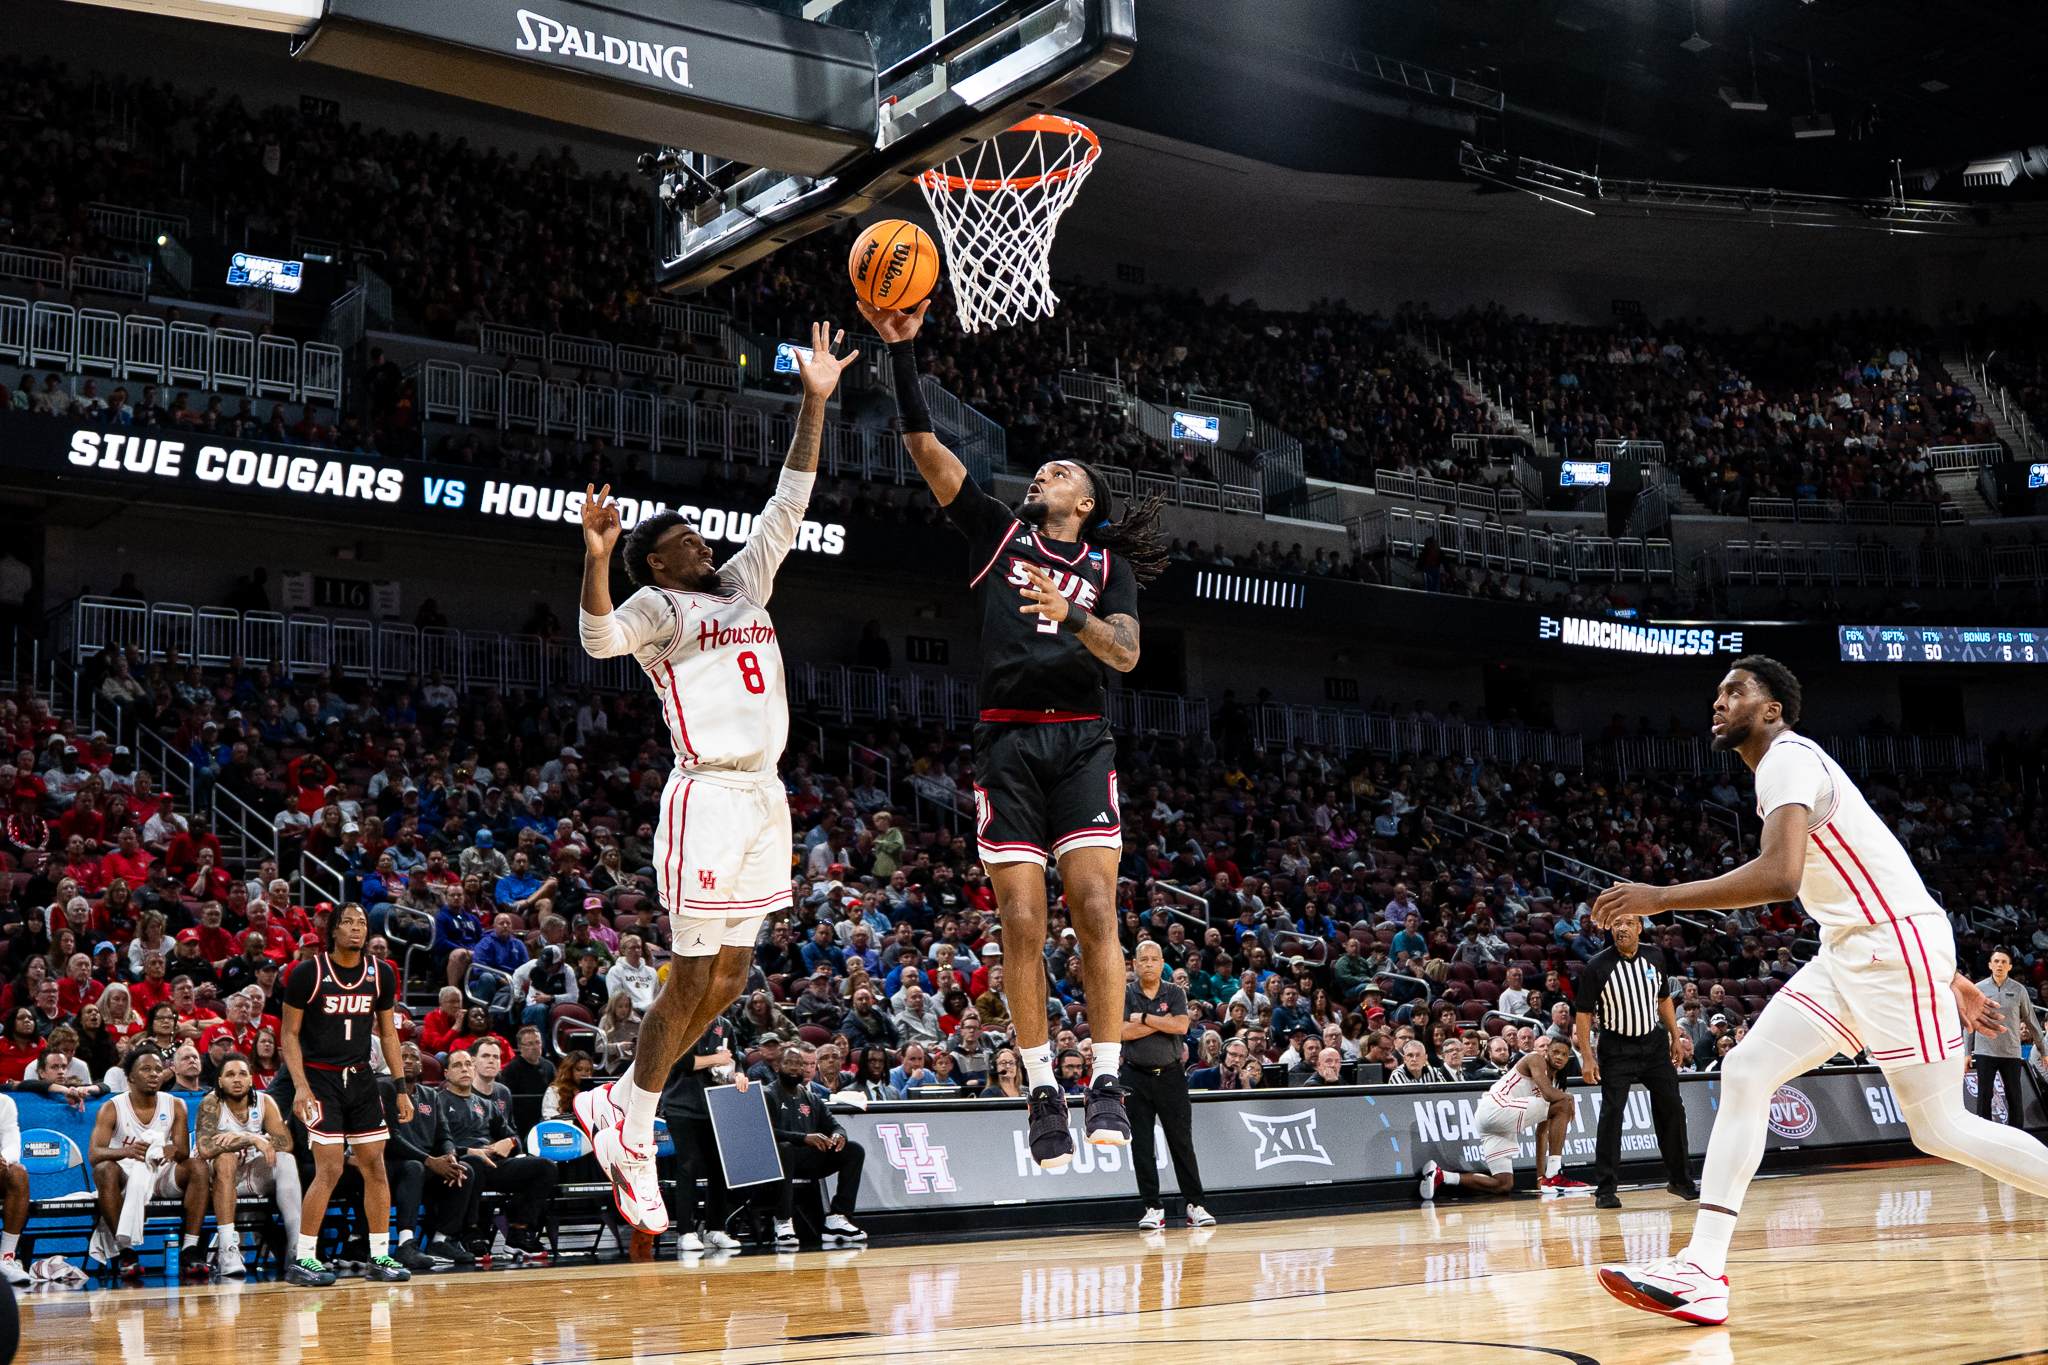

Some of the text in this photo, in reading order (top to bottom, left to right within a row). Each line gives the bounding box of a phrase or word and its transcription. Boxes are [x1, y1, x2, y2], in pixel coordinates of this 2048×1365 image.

[516, 9, 692, 88] SPALDING
[858, 239, 879, 281] NCAA
[878, 242, 911, 297] Wilson
[68, 430, 404, 502] SIUE COUGARS
[423, 476, 466, 507] VS
[324, 580, 365, 607] 116
[697, 619, 776, 651] Houston
[1845, 630, 2035, 643] FG% 3PT% FT% BONUS FLS TOL
[912, 639, 945, 661] 117
[1848, 643, 2034, 661] 41 10 50 5 3
[737, 651, 765, 694] 8
[1331, 680, 1356, 700] 118
[698, 869, 717, 890] UH
[323, 994, 373, 1014] SIUE
[344, 1019, 352, 1040] 1
[1413, 1098, 1482, 1143] NCA
[1770, 1101, 1804, 1122] OVC
[876, 1123, 957, 1194] UH
